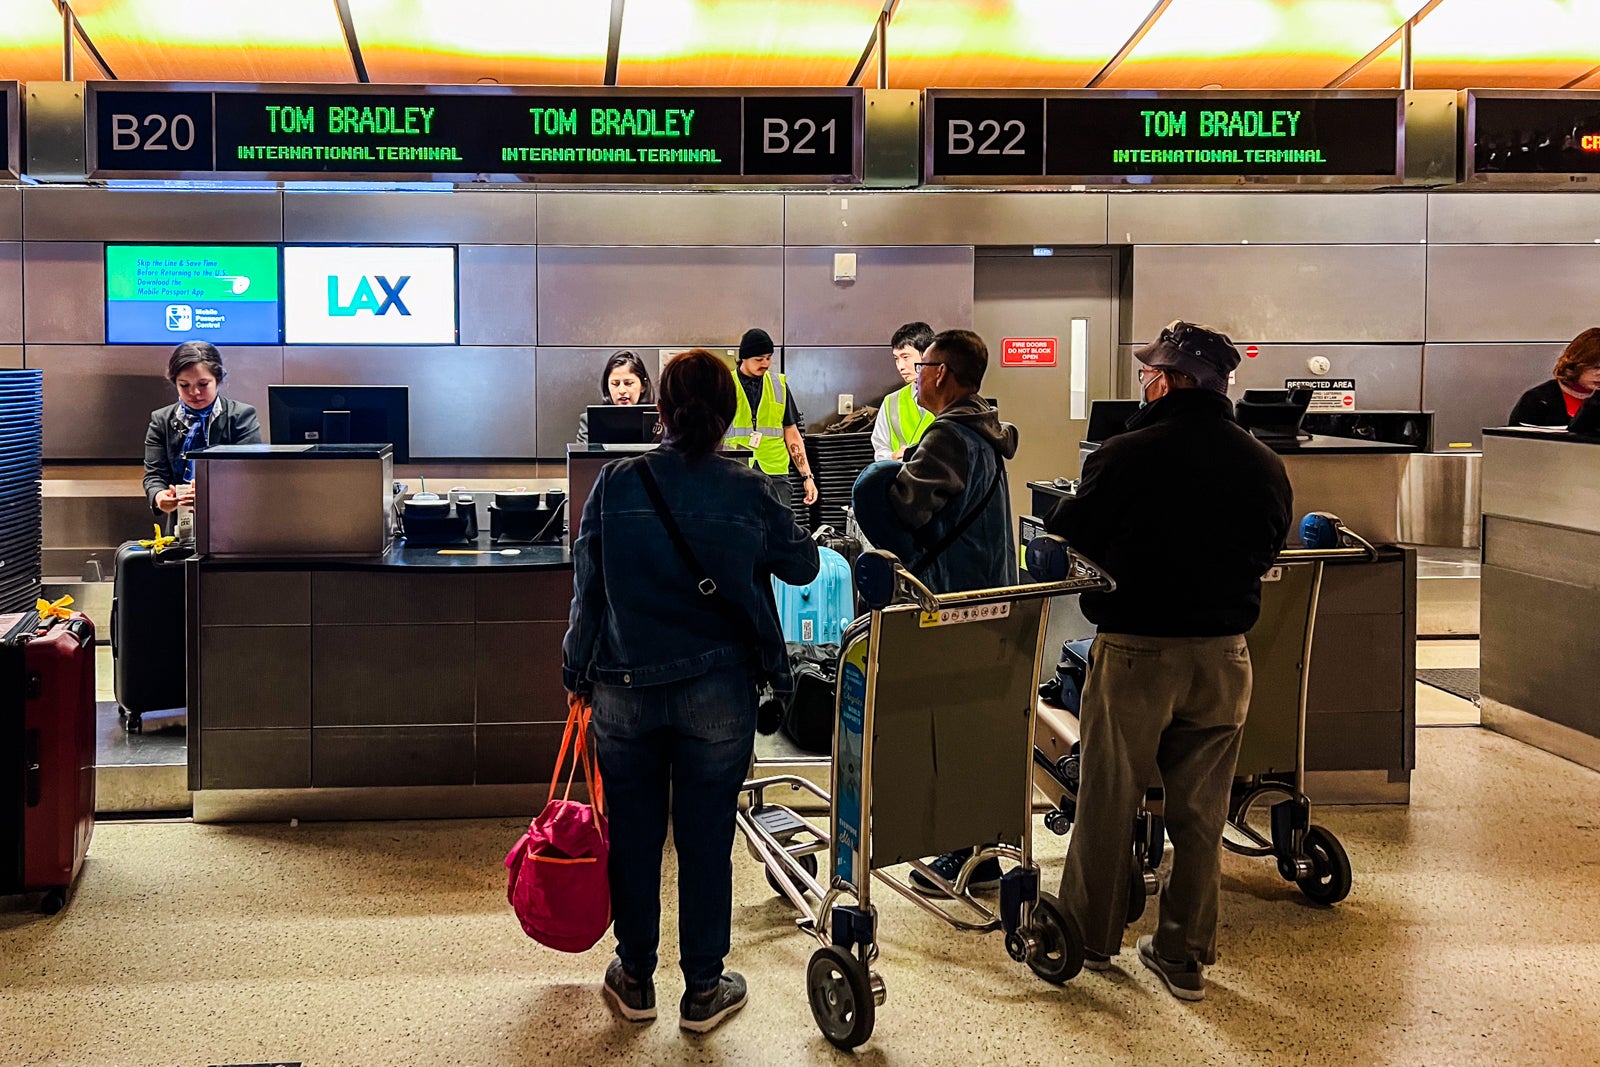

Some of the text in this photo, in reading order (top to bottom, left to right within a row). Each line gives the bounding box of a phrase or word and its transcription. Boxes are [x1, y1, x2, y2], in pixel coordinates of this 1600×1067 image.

[112, 114, 195, 151] B20
[265, 106, 435, 134] TOM BRADLEY
[529, 107, 695, 137] TOM BRADLEY
[1140, 110, 1301, 138] TOM BRADLEY
[763, 118, 836, 154] B21
[948, 119, 1026, 155] B22
[137, 259, 150, 268] Skip
[153, 259, 162, 267] the
[165, 259, 177, 267] Line
[203, 259, 217, 267] Time
[160, 269, 191, 278] Returning
[161, 288, 190, 296] Passport
[192, 288, 205, 296] App
[172, 278, 181, 286] the
[327, 275, 412, 317] LAX
[195, 315, 225, 323] Passport
[1333, 381, 1353, 389] AREA
